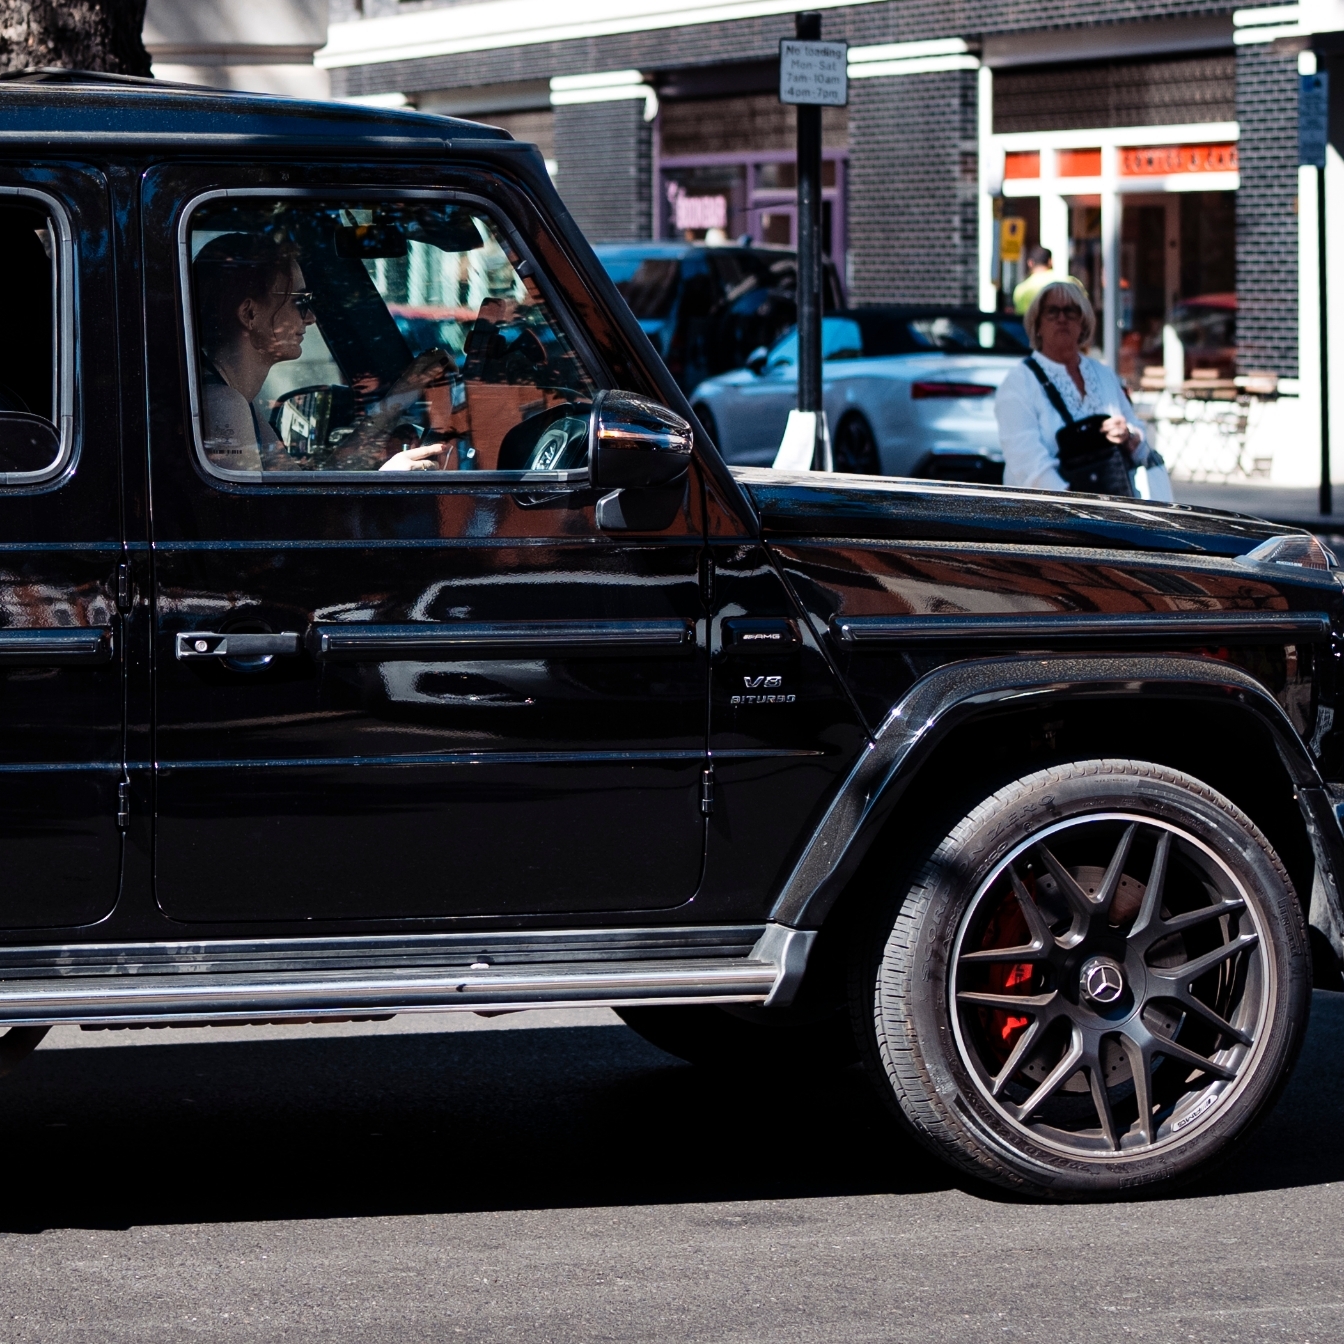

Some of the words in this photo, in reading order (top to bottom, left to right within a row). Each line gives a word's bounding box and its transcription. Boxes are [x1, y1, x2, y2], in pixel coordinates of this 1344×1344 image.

[786, 45, 801, 56] No
[804, 46, 842, 60] loading
[743, 676, 782, 688] V8
[730, 694, 796, 705] BITURBO
